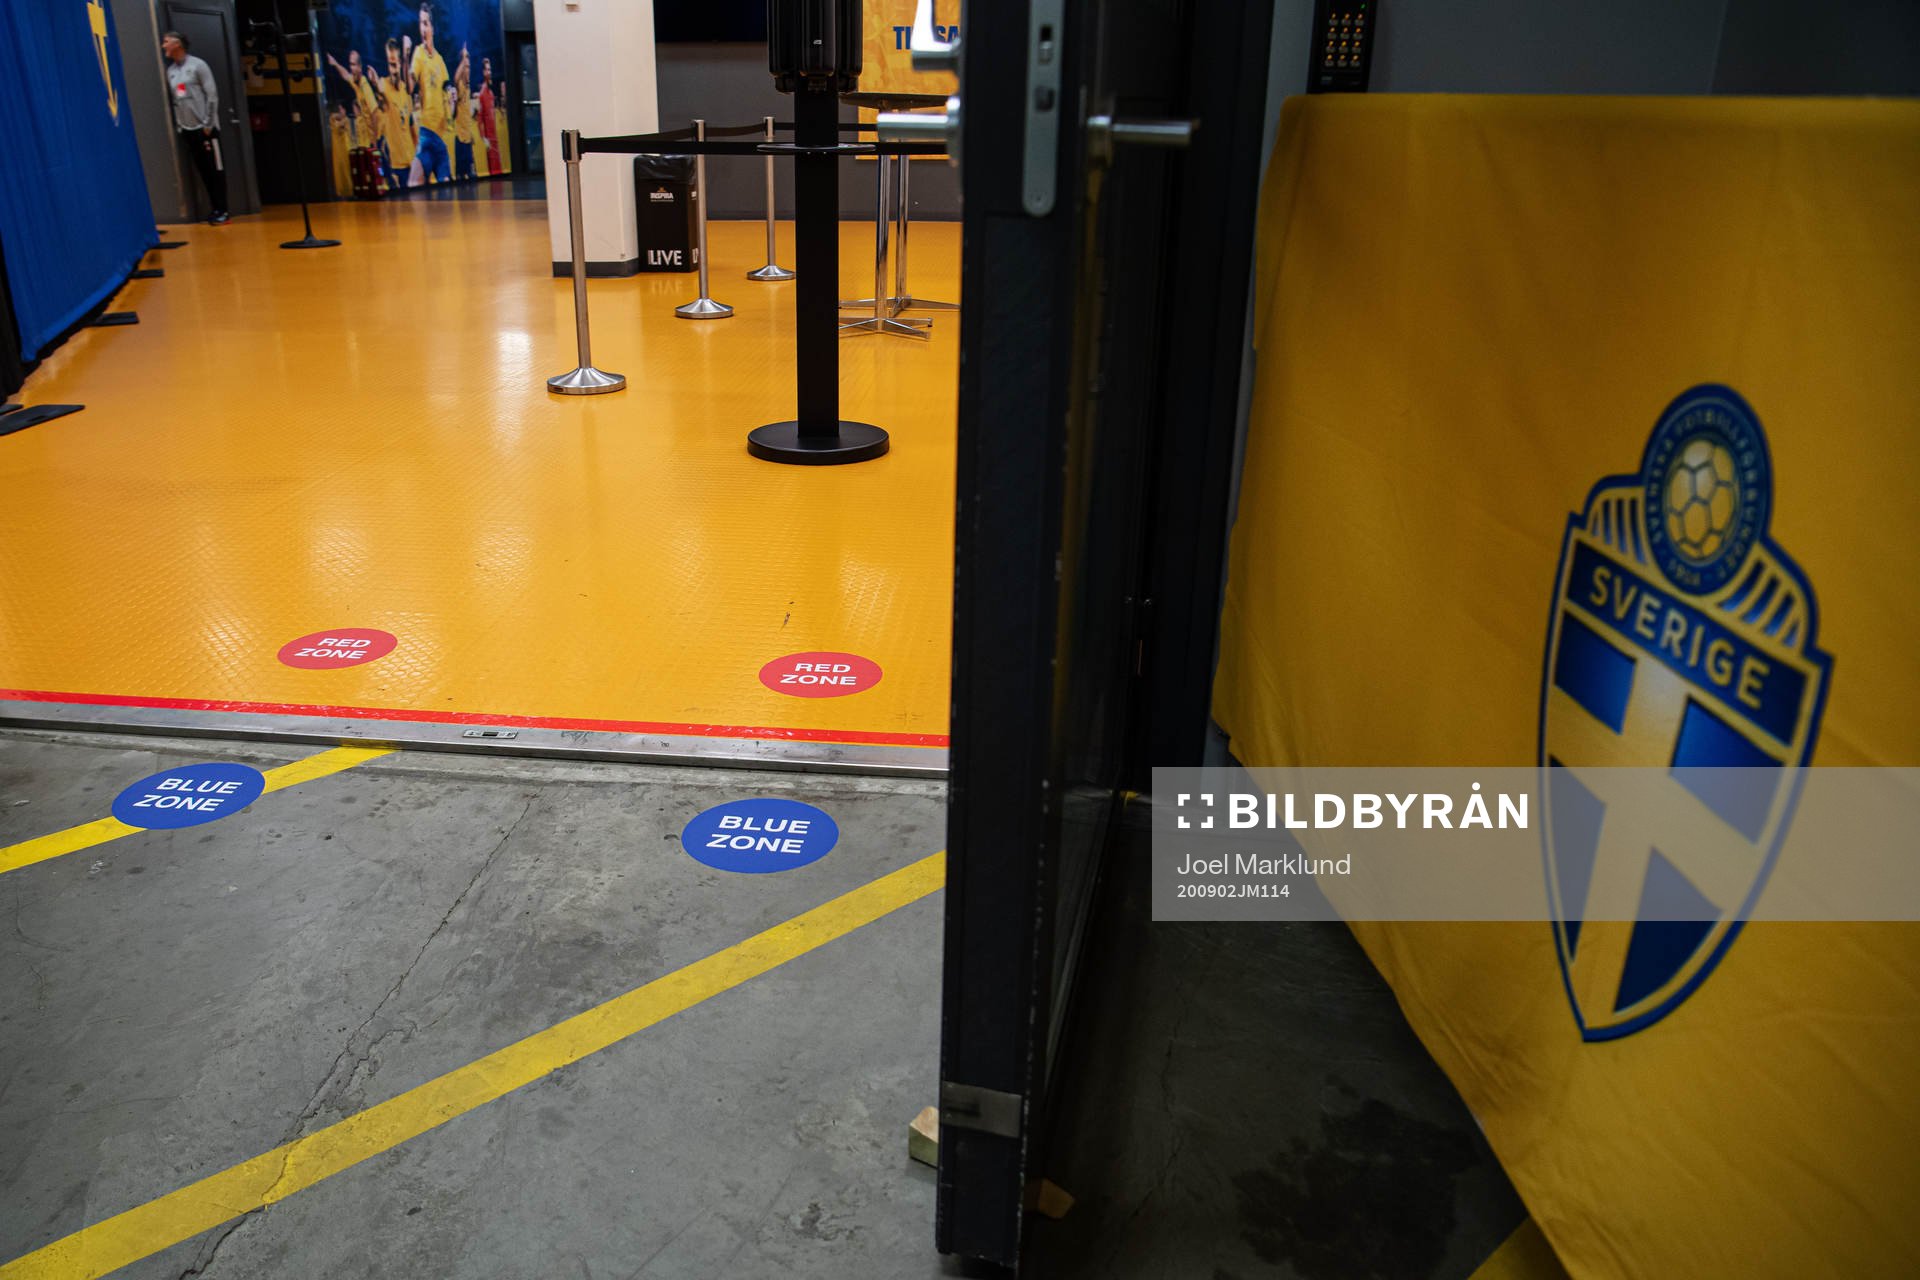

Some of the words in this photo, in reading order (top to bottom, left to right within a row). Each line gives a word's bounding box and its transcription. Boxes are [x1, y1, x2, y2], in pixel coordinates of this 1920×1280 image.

[648, 250, 682, 265] LIVE
[317, 637, 371, 648] RED
[1590, 566, 1770, 709] SVERIGE
[294, 648, 367, 660] ZONE
[795, 663, 851, 673] RED
[780, 674, 857, 685] ZONE
[156, 778, 243, 794] BLUE
[132, 794, 225, 812] ZONE
[718, 815, 811, 834] BLUE
[705, 834, 805, 854] ZONE
